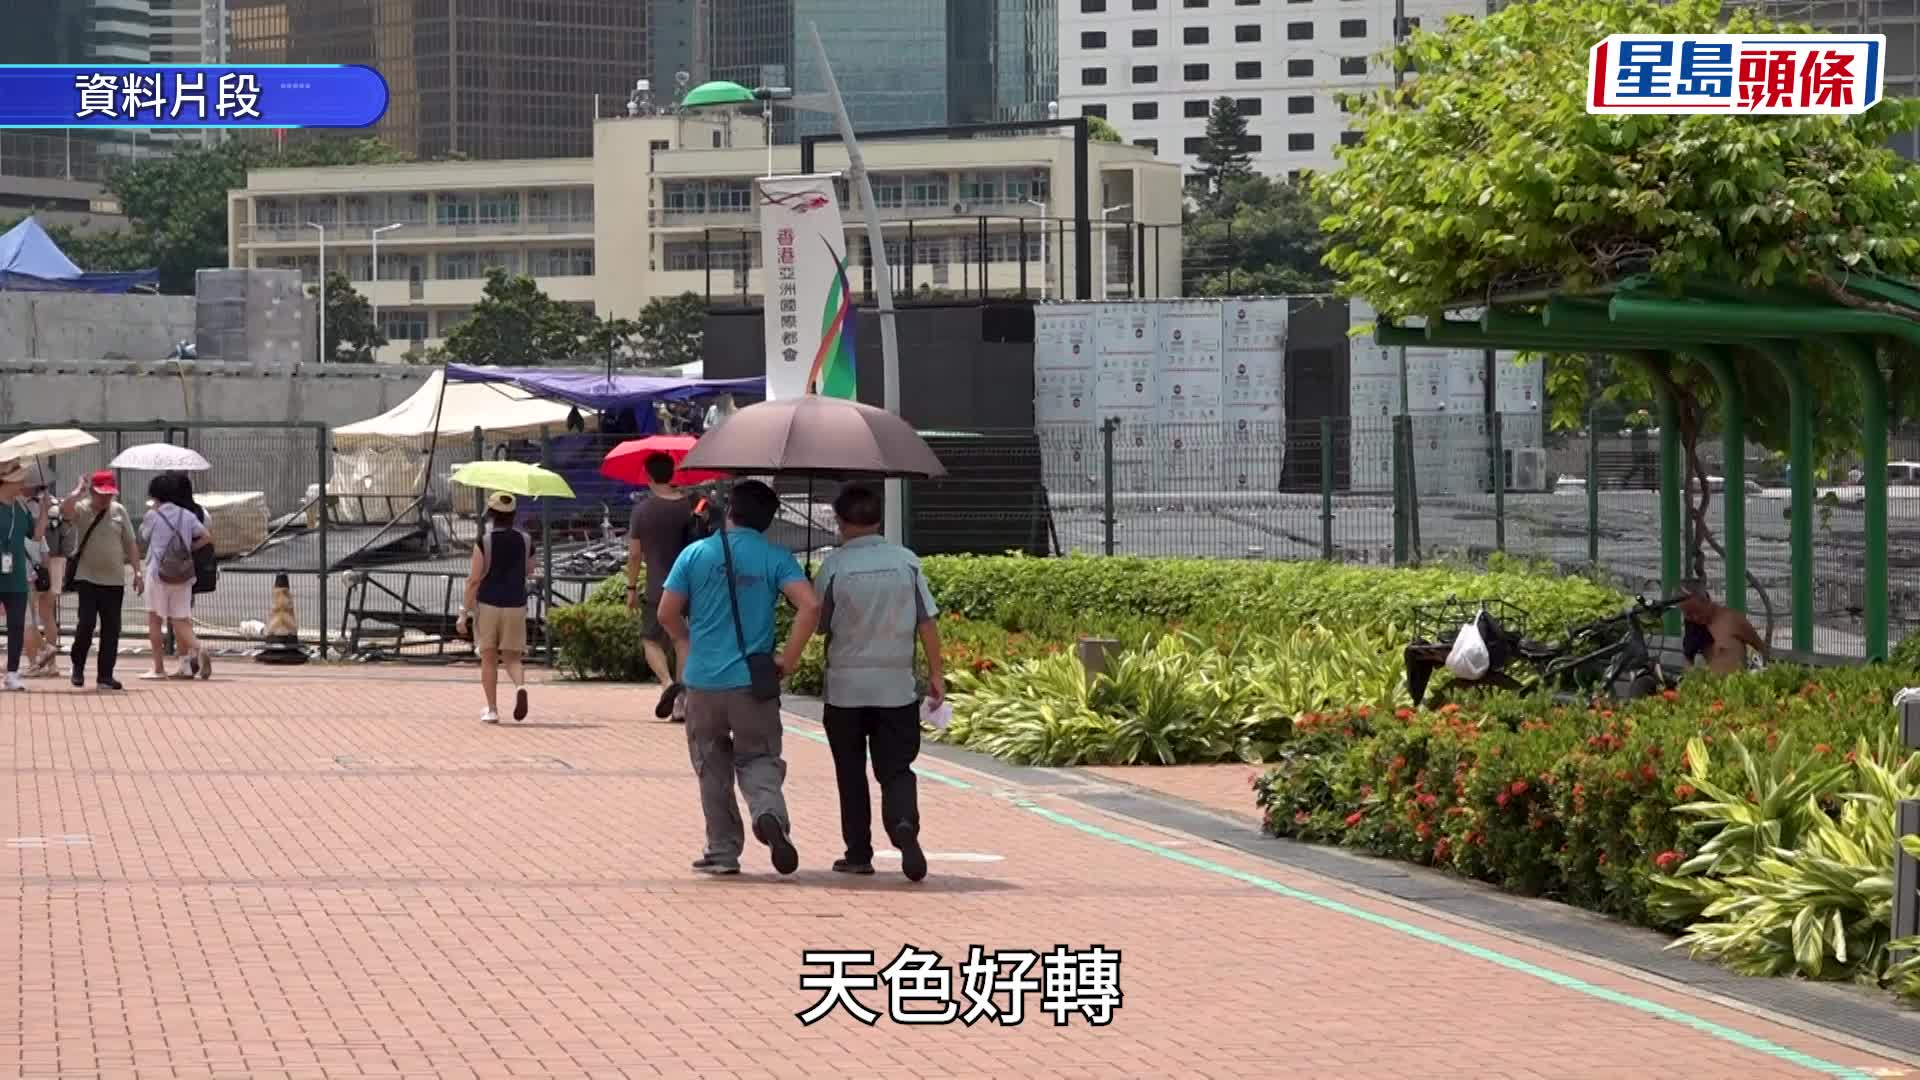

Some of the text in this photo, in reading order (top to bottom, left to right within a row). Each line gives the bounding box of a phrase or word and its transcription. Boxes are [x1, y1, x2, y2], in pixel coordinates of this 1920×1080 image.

[776, 228, 799, 363] 香港亞洲國際都會
